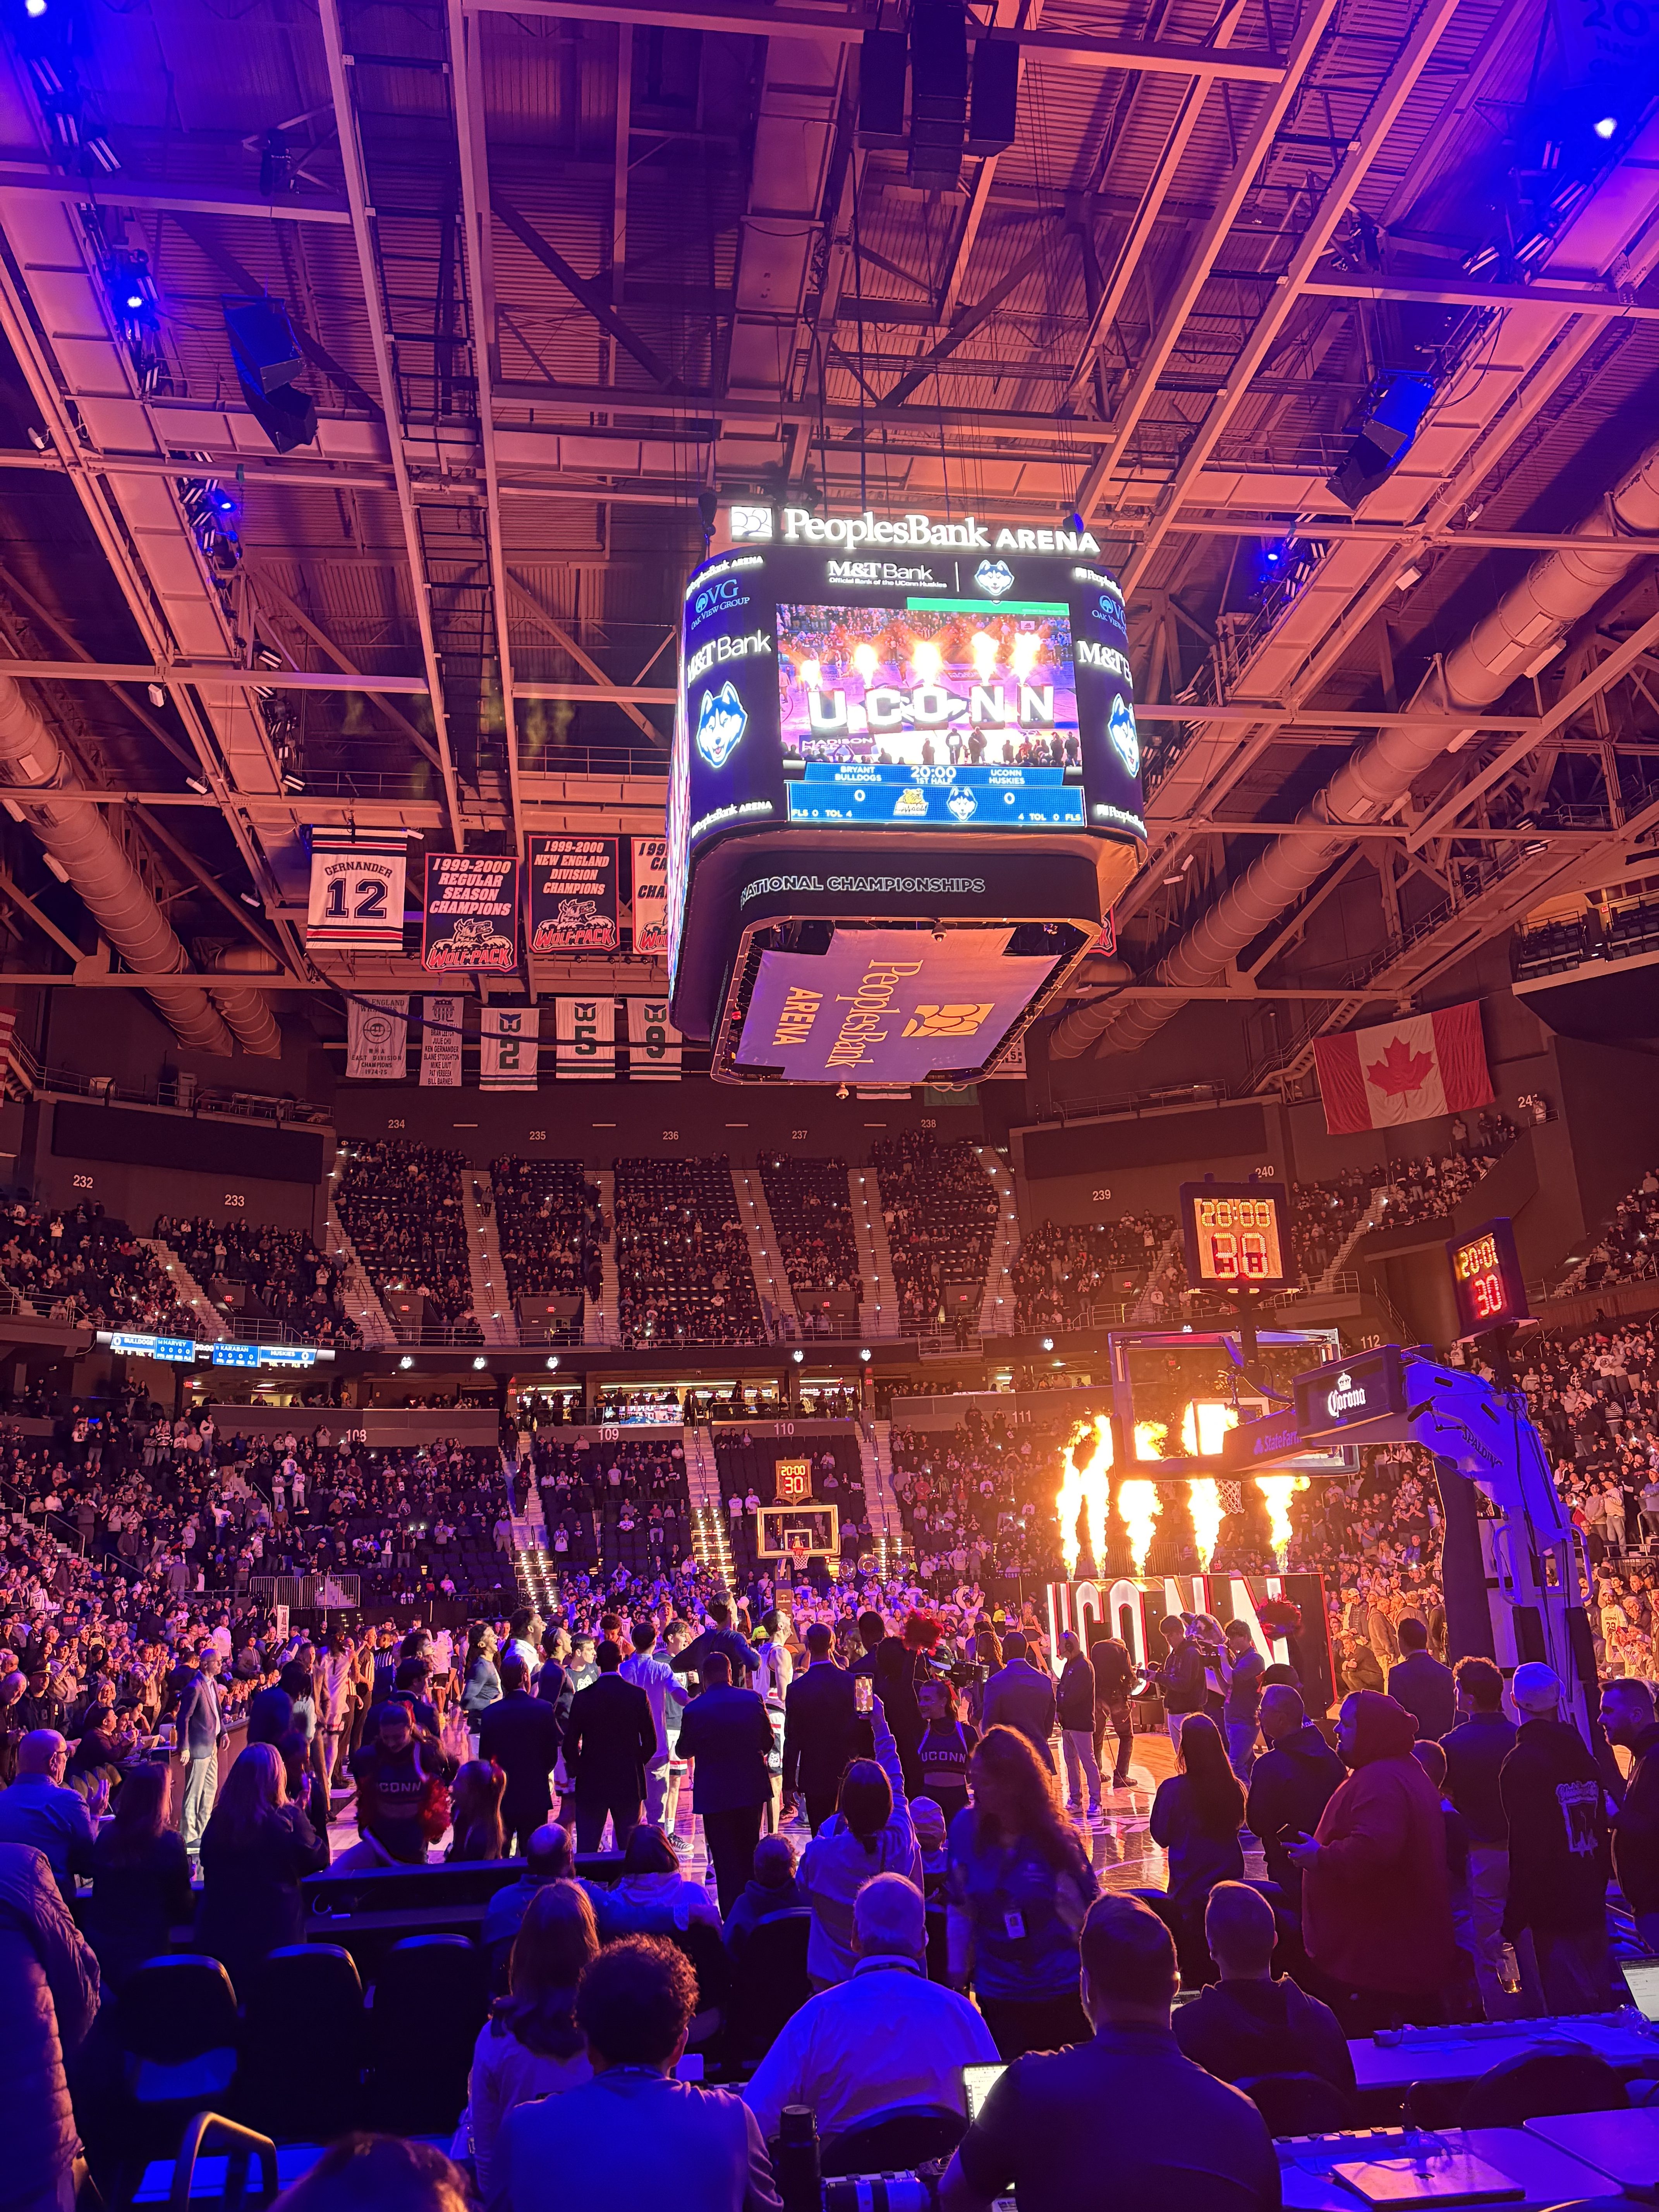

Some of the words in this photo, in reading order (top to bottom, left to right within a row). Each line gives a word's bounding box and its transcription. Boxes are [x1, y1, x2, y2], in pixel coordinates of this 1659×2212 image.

[783, 508, 991, 549] PeoplesBank
[996, 528, 1101, 552] ARENA
[884, 563, 933, 580] Bank
[701, 605, 719, 620] VIEW
[720, 597, 750, 610] GROUP
[1092, 610, 1108, 622] OAK
[718, 629, 772, 661] Bank
[808, 686, 1054, 728] UCONN
[802, 737, 873, 747] MADISON
[835, 773, 882, 782] BULLDOGS
[910, 766, 957, 778] 20:00
[854, 789, 866, 802] 0
[1004, 792, 1015, 805] 0
[739, 801, 773, 813] ARENA
[544, 841, 604, 853] 1999-2000
[432, 858, 512, 874] 1999-2000
[534, 854, 560, 866] NEW
[560, 855, 610, 867] ENGLAND
[325, 861, 393, 878] GERNANDER
[550, 869, 599, 880] DIVISION
[438, 872, 503, 887] REGULAR
[443, 886, 500, 901] SEASON
[543, 882, 605, 895] CHAMPIONS
[741, 876, 824, 906] NATIONAL
[826, 876, 986, 893] CHAMPIONSHIPS
[325, 878, 388, 919] 12
[429, 900, 512, 916] CHAMPIONS
[772, 986, 823, 1045] ARENA
[824, 959, 924, 1068] PeoplesBank
[575, 1025, 596, 1055] 5
[646, 1025, 666, 1059] 9
[499, 1039, 520, 1070] 2
[1518, 1094, 1538, 1108] 24
[388, 1119, 405, 1129] 234
[921, 1119, 936, 1128] 238
[529, 1131, 546, 1140] 235
[663, 1130, 679, 1140] 236
[792, 1130, 808, 1140] 237
[1255, 1166, 1274, 1178] 240
[73, 1175, 93, 1189] 232
[225, 1194, 245, 1207] 233
[1092, 1189, 1111, 1201] 239
[1214, 1232, 1269, 1278] 30
[1475, 1274, 1502, 1315] 30
[124, 1338, 154, 1346] BULLDOGS
[195, 1344, 214, 1352] 20:00
[1361, 1334, 1380, 1349] 112
[1328, 1388, 1366, 1418] Corona
[1013, 1410, 1032, 1423] 111
[346, 1429, 367, 1442] 108
[598, 1429, 619, 1441] 109
[774, 1423, 794, 1435] 110
[781, 1465, 806, 1476] 20:00
[785, 1476, 804, 1494] 30
[921, 1751, 967, 1764] UCONN
[378, 1781, 421, 1793] CONN
